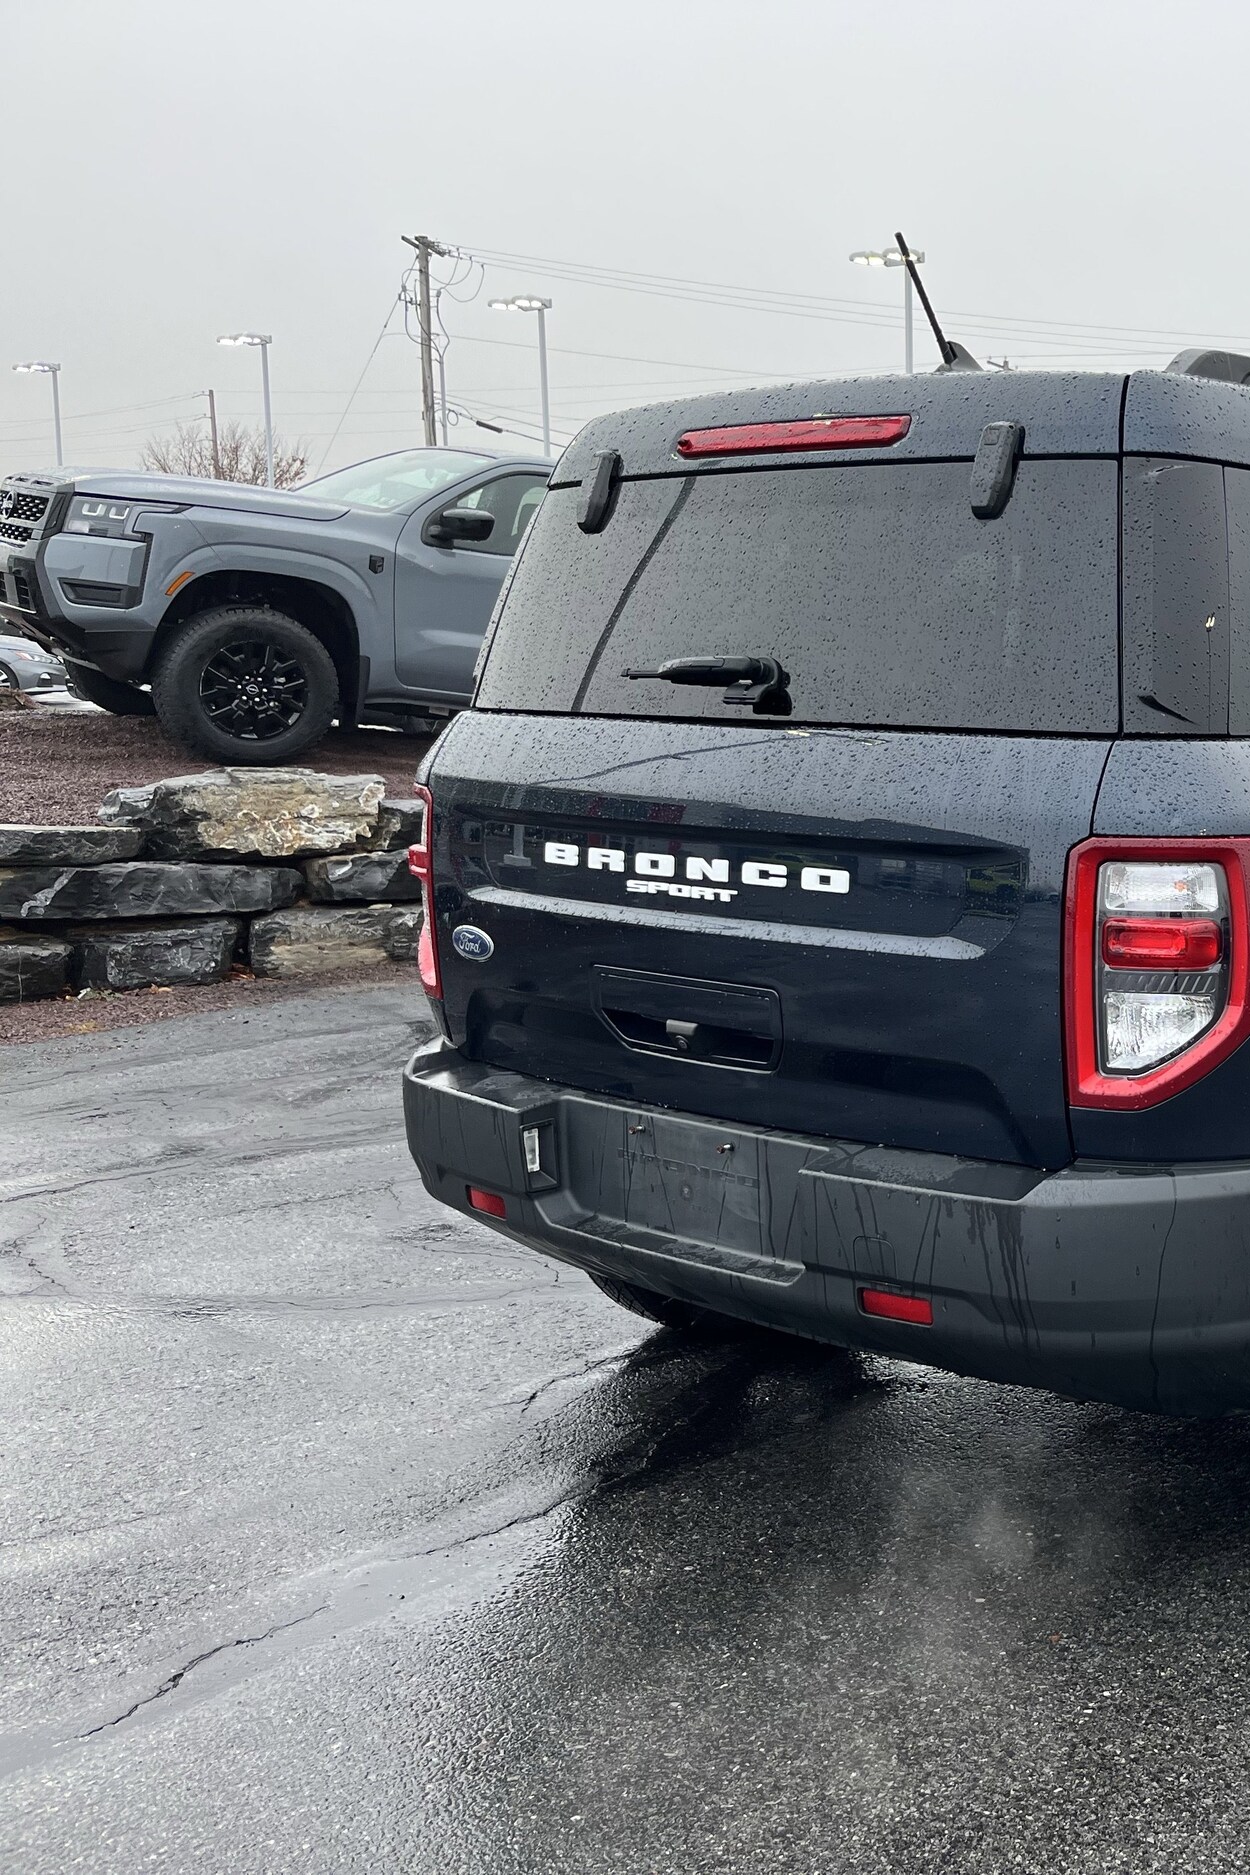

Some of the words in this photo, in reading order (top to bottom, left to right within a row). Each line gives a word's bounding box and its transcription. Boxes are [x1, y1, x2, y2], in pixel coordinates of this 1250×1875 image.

[544, 841, 850, 894] BRONCO
[626, 879, 738, 902] SPORT
[458, 931, 482, 954] Ford
